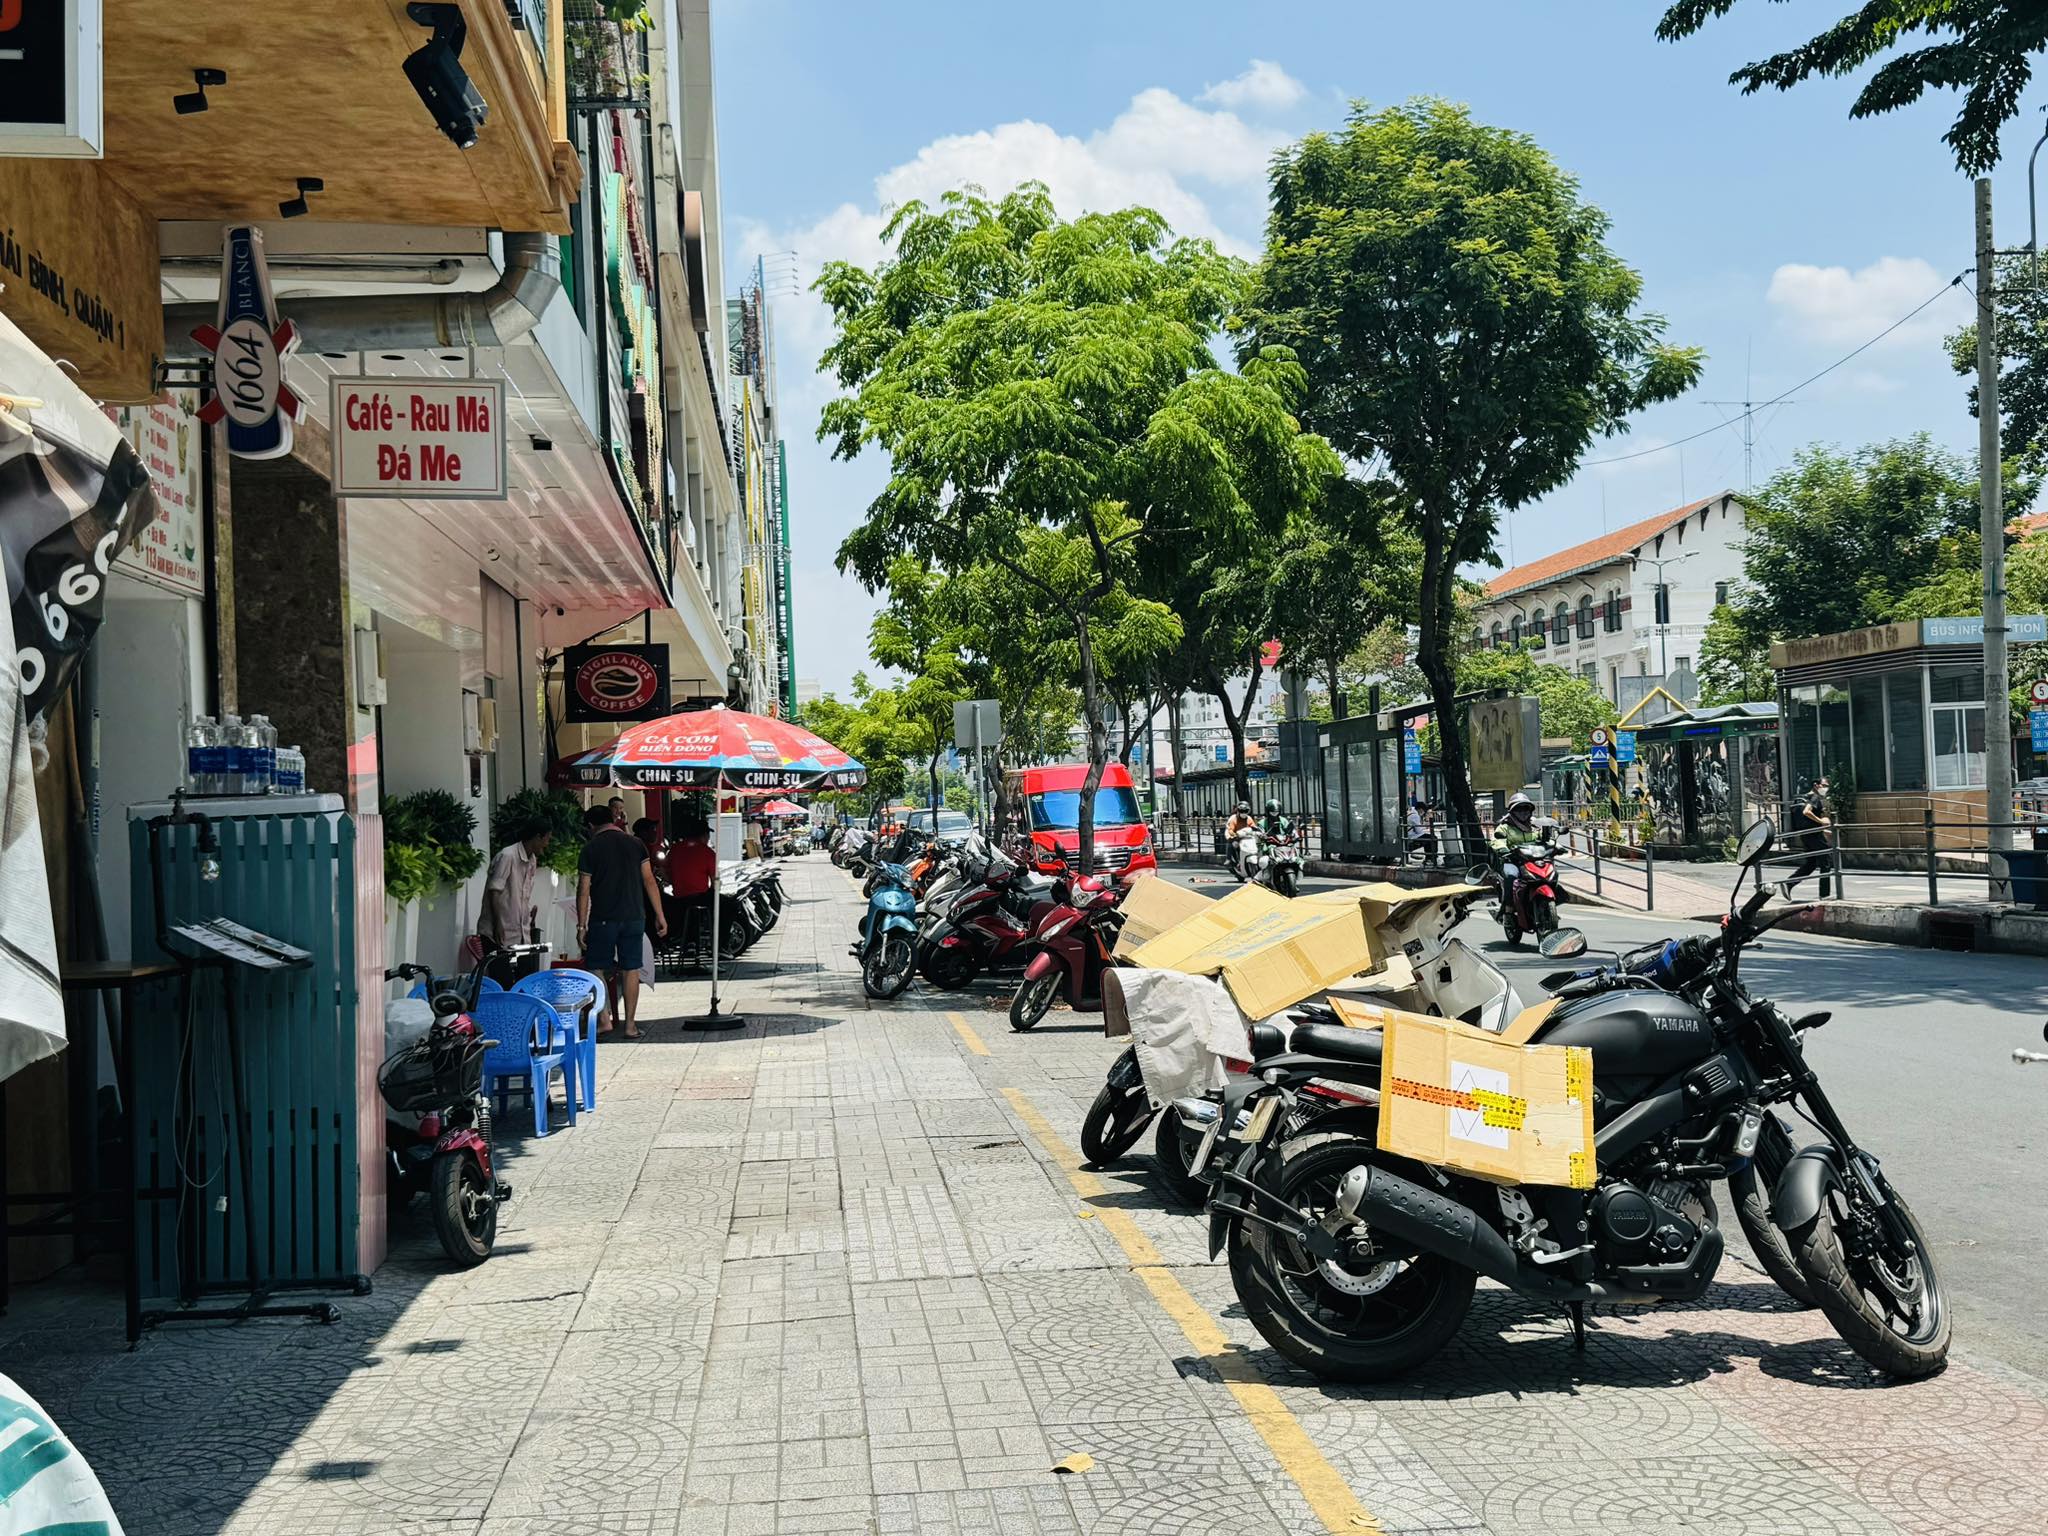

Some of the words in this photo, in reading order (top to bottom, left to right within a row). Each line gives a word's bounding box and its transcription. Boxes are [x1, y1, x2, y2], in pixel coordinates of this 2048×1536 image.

[118, 320, 124, 351] 1
[226, 328, 266, 414] 1664
[346, 393, 393, 431] Café
[411, 395, 450, 432] Rau
[456, 396, 490, 432] Má
[377, 444, 411, 481] Đá
[420, 445, 462, 482] Me
[145, 544, 157, 571] 113
[1930, 625, 1955, 636] BUS
[581, 656, 653, 680] HIGHLANDS
[2039, 686, 2045, 696] 5
[590, 694, 645, 709] COFFEE
[636, 769, 695, 782] CHIN-SU
[744, 772, 801, 785] CHIN-SU
[1653, 1017, 1699, 1032] YAMAHA
